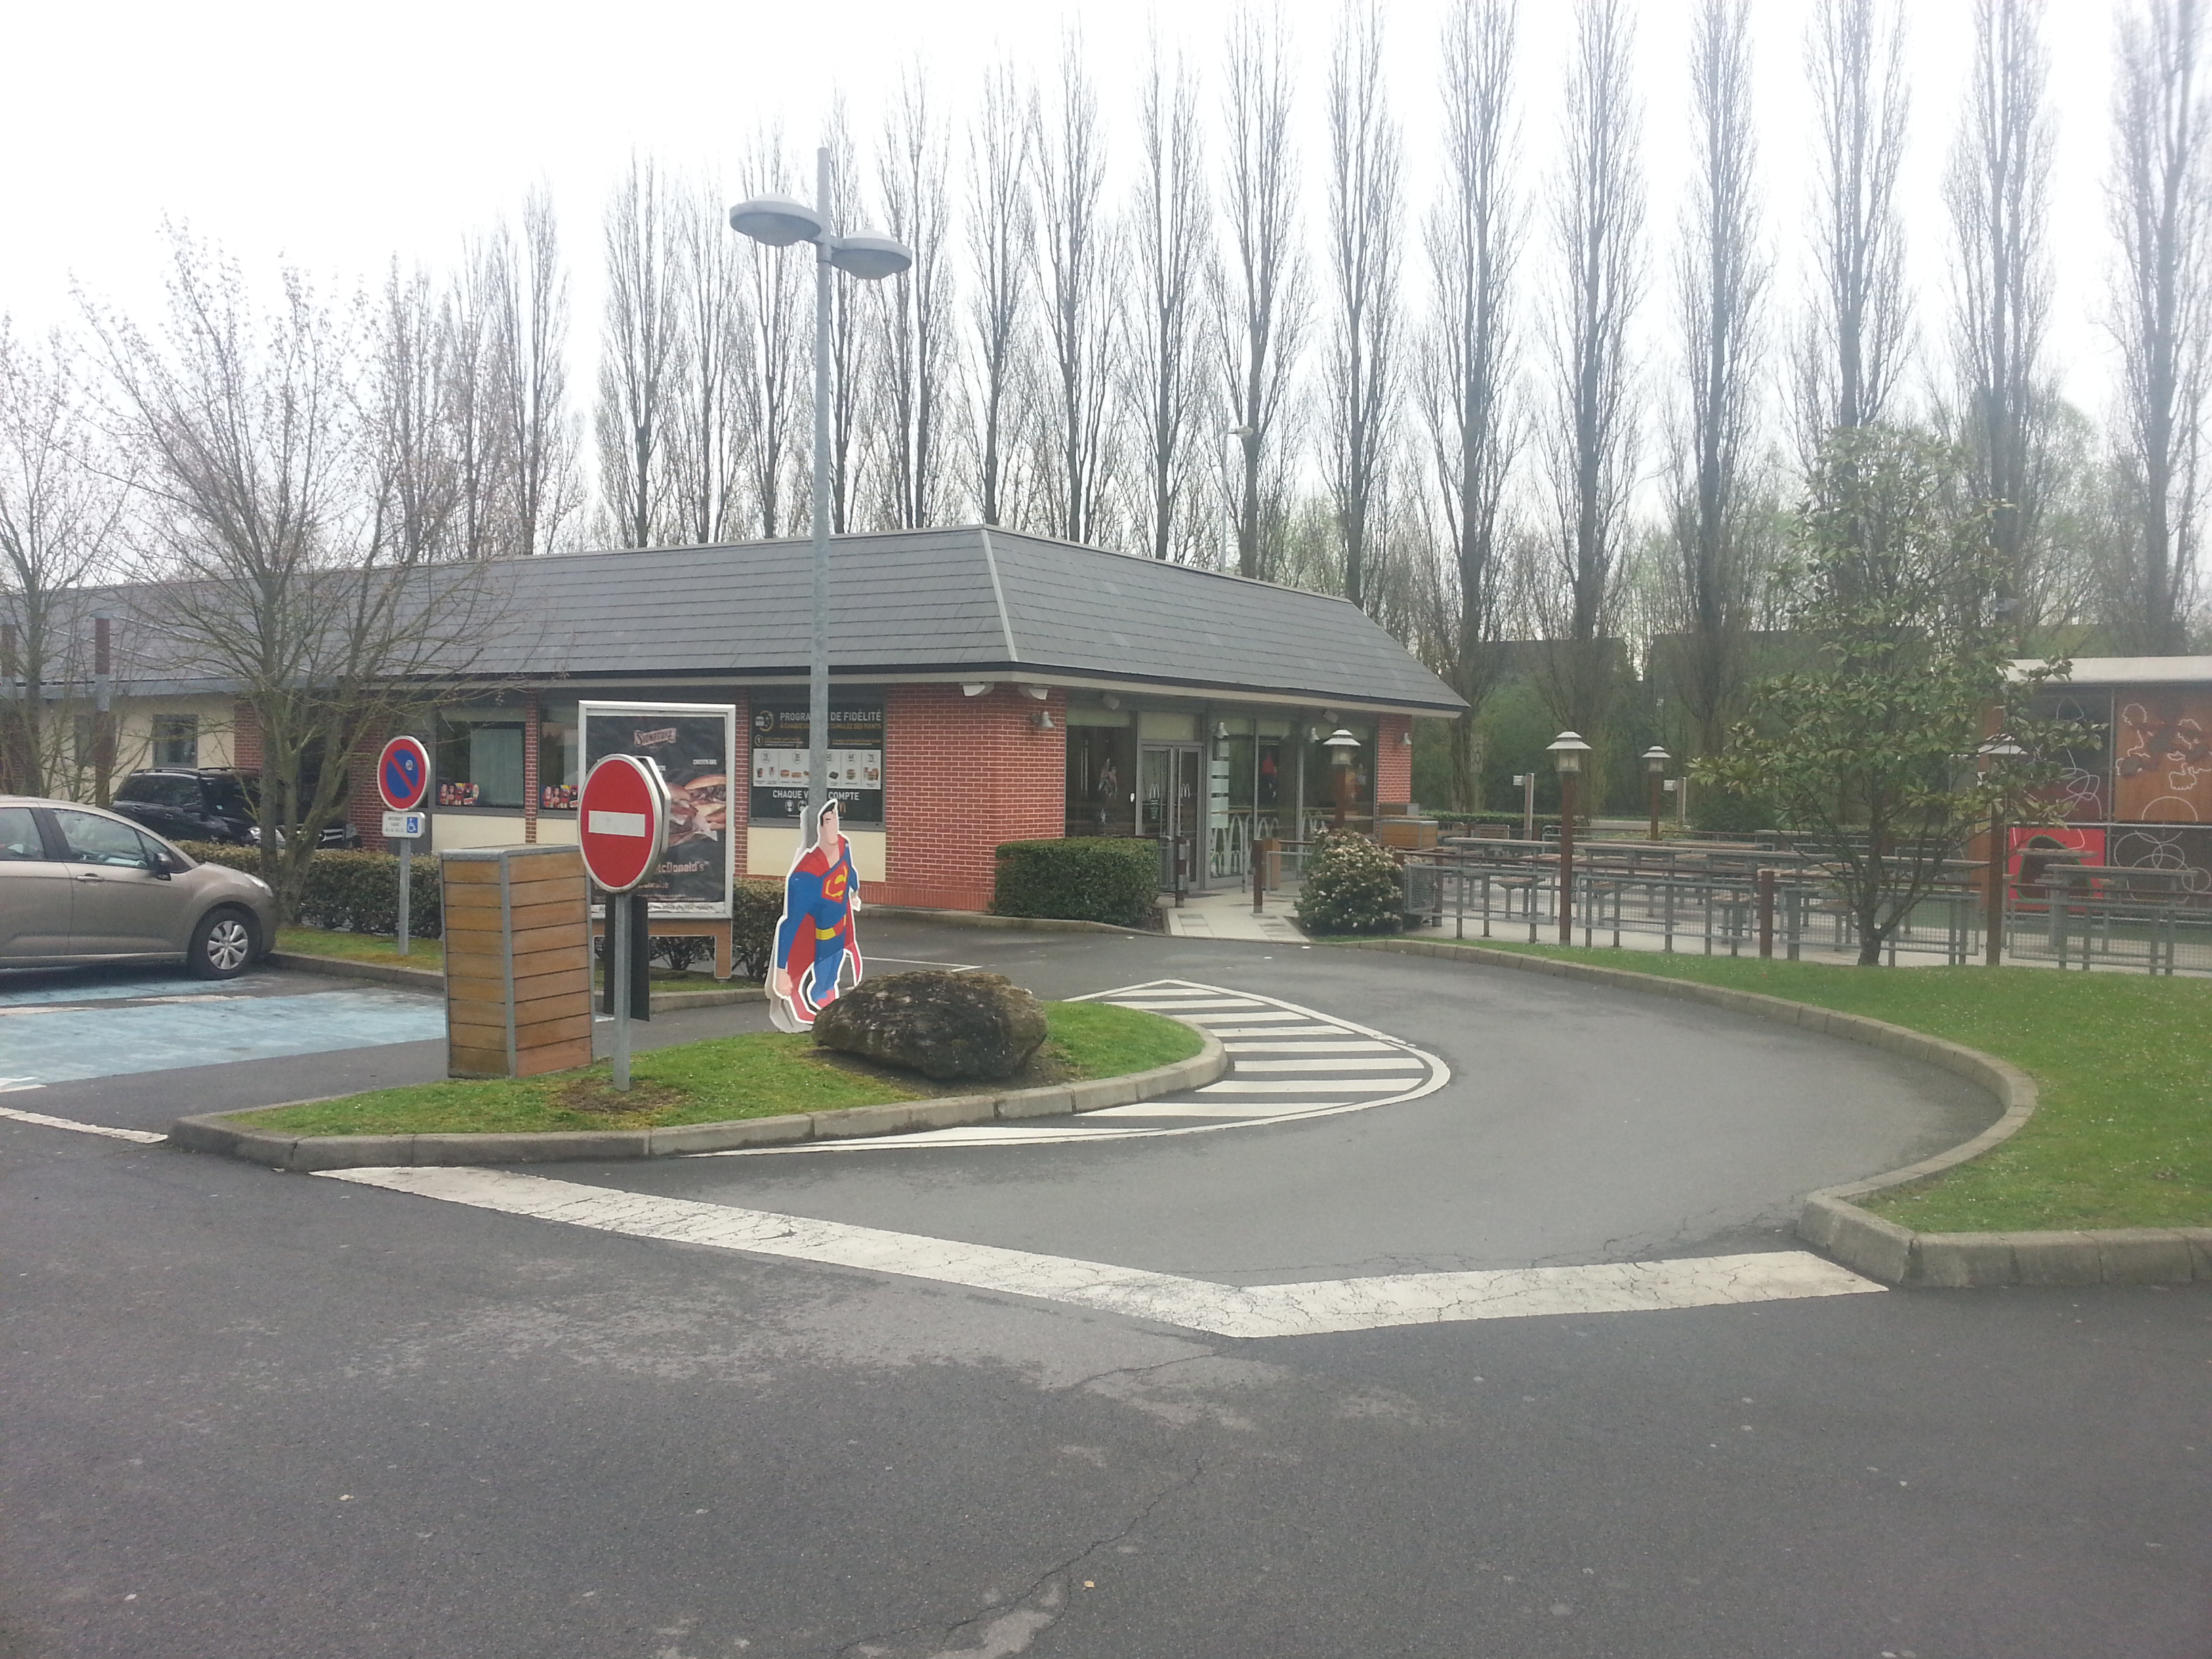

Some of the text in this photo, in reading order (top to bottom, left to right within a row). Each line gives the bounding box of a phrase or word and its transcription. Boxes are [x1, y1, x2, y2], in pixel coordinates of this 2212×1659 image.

[780, 709, 882, 721] PROGRA DE FIDÉLITÉ
[773, 790, 802, 798] CHAQUE
[828, 792, 859, 800] COMPTE
